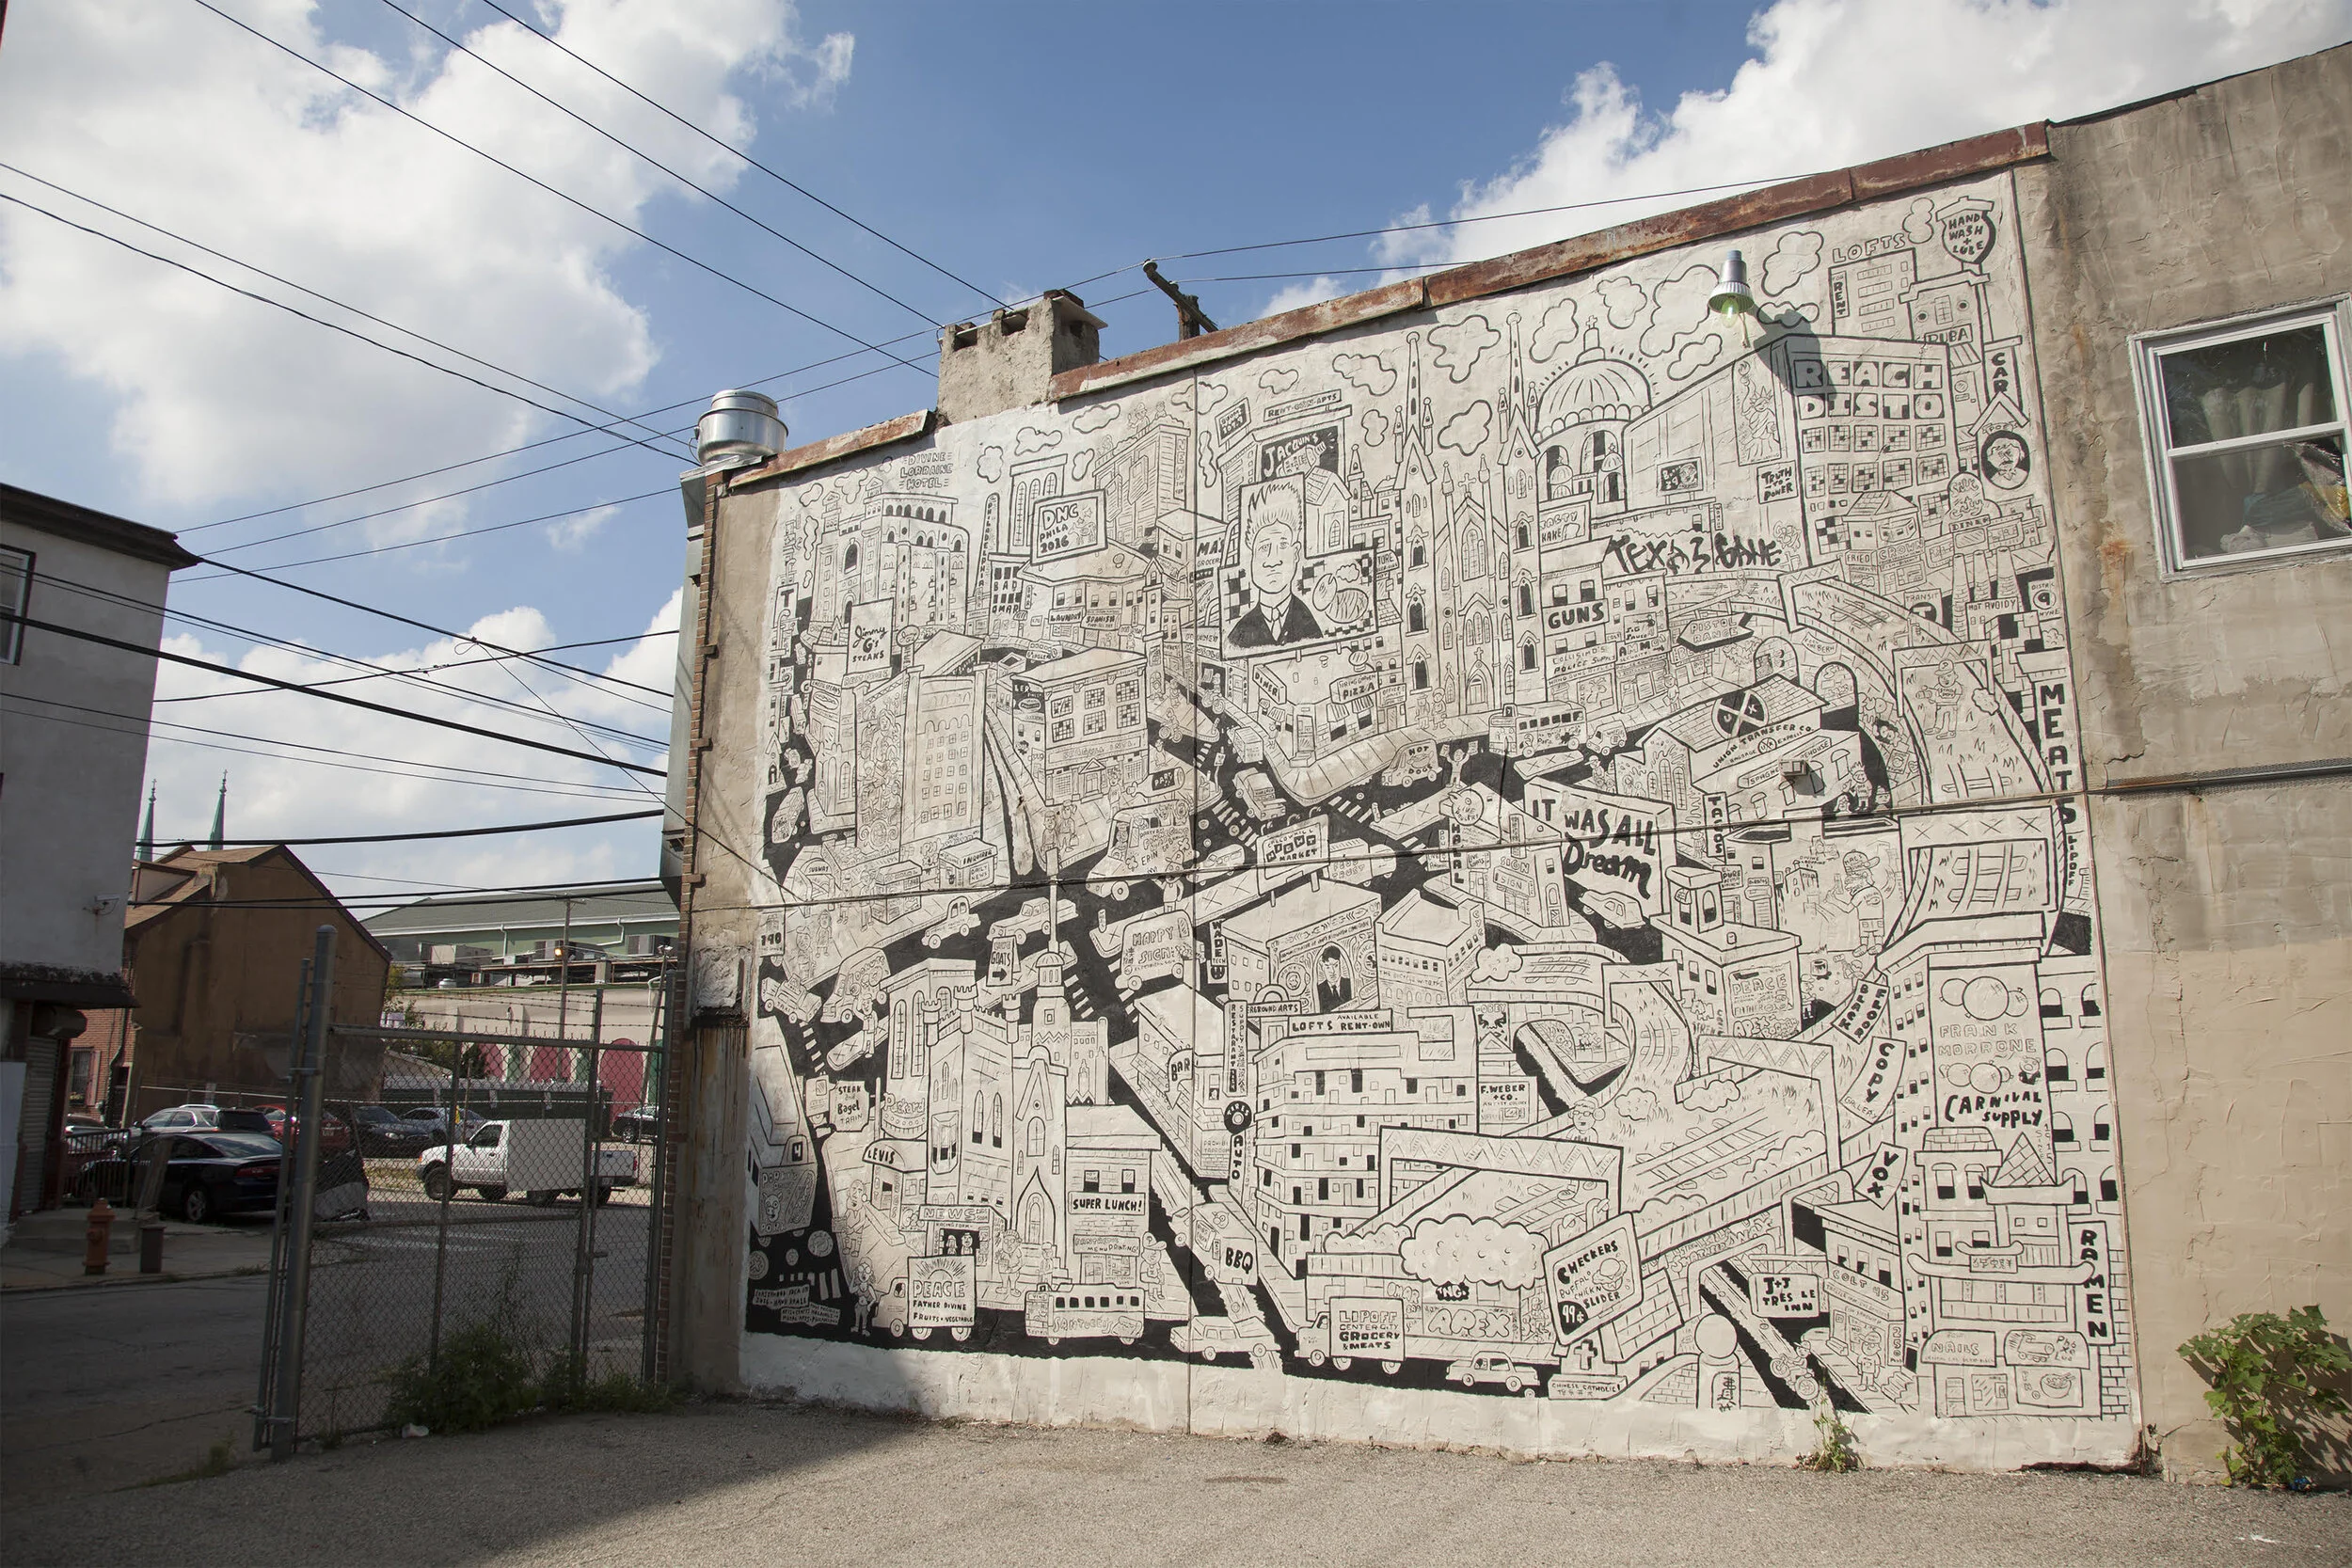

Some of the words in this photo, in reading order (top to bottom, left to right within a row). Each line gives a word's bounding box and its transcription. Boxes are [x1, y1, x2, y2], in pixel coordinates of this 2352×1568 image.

[1948, 214, 1980, 229] HAND
[1948, 227, 1983, 240] WASH
[1833, 233, 1907, 263] LOFTS
[1953, 243, 1983, 255] LUBE
[1834, 282, 1846, 315] RENT
[1992, 353, 2008, 392] CAR
[908, 452, 946, 464] DIVINE
[900, 464, 953, 477] LORRAINE
[1761, 469, 1791, 485] TRUTH
[906, 477, 942, 489] HOTEL
[1764, 485, 1793, 500] POWER
[1041, 503, 1079, 531] DNC
[1040, 524, 1068, 542] PHILA
[1542, 529, 1562, 543] KAKE
[978, 502, 994, 588] PHILADELPHIA
[1041, 537, 1069, 553] 2016
[1880, 539, 1924, 560] CROWN
[1377, 551, 1394, 565] TORE
[1847, 553, 1870, 563] FRIED
[993, 580, 1018, 591] BAD
[1906, 594, 1939, 602] TRANSIT
[993, 605, 1021, 613] OMAR
[1548, 603, 1604, 628] GUNS
[1050, 612, 1082, 623] LAUNDRY
[1086, 614, 1116, 624] SPANISH
[1691, 619, 1737, 632] PISTOL
[854, 626, 887, 648] Jimmy
[1693, 628, 1739, 643] RANGE
[1817, 642, 1836, 653] BERN
[852, 652, 884, 662] STEAKS
[1255, 673, 1279, 697] DINER
[1343, 685, 1375, 698] PIZZA
[1409, 746, 1429, 756] HOT
[1712, 744, 1738, 768] UNION
[1740, 724, 1795, 744] TRANSFER
[1800, 724, 1815, 733] CO.
[1408, 765, 1434, 774] DOGS
[1533, 800, 1556, 821] IT
[1565, 809, 1611, 848] WAS
[1708, 796, 1723, 853] TACOS
[1612, 815, 1656, 856] ALL
[963, 850, 993, 865] INQUIRER
[1279, 848, 1318, 862] MARKET
[1500, 859, 1530, 874] SIGN
[1565, 832, 1652, 900] Dream
[1502, 877, 1522, 890] SIGN
[1132, 927, 1174, 946] HAPPY
[1212, 921, 1223, 958] WADE
[991, 950, 1011, 967] GOATS
[1733, 974, 1788, 994] PEACE
[1292, 1021, 1333, 1032] LOFTS
[1341, 1022, 1391, 1030] RENT-OWN
[1940, 1022, 2018, 1037] FRANK
[1938, 1038, 2037, 1056] MORRONE
[1171, 1058, 1190, 1081] BAR
[1866, 1042, 1895, 1103] COPY
[838, 1085, 861, 1095] STEAK
[1481, 1084, 1526, 1094] F.WEBER
[837, 1101, 860, 1116] Bagel
[883, 1093, 926, 1114] Packard
[1845, 1096, 1878, 1120] GALLERY
[1945, 1091, 2042, 1122] CARNIVAL
[840, 1114, 863, 1124] TRAIN
[1982, 1109, 2042, 1129] SUPPLY
[867, 1149, 896, 1164] LEVIS
[1232, 1134, 1245, 1180] AUTO
[1867, 1150, 1899, 1198] VOX
[1073, 1199, 1102, 1210] SUPER
[1105, 1199, 1142, 1212] LUNCH!
[925, 1208, 976, 1219] NEWS
[1226, 1247, 1253, 1274] BBQ
[1558, 1240, 1618, 1284] CHECKERS
[913, 1281, 965, 1298] PEACE
[1834, 1270, 1867, 1288] COLT
[1873, 1285, 1889, 1301] 45
[2080, 1229, 2107, 1338] RAMEN
[944, 1302, 966, 1310] DIVINE
[1583, 1291, 1620, 1309] SLIDER
[1785, 1303, 1813, 1312] INN
[914, 1313, 939, 1323] FRUITS
[1339, 1310, 1397, 1323] LIPOFF
[1428, 1308, 1510, 1338] APEX
[1339, 1332, 1400, 1341] GROCERY
[1931, 1343, 1979, 1355] NAILS
[1582, 1384, 1616, 1393] CATHOLIC
